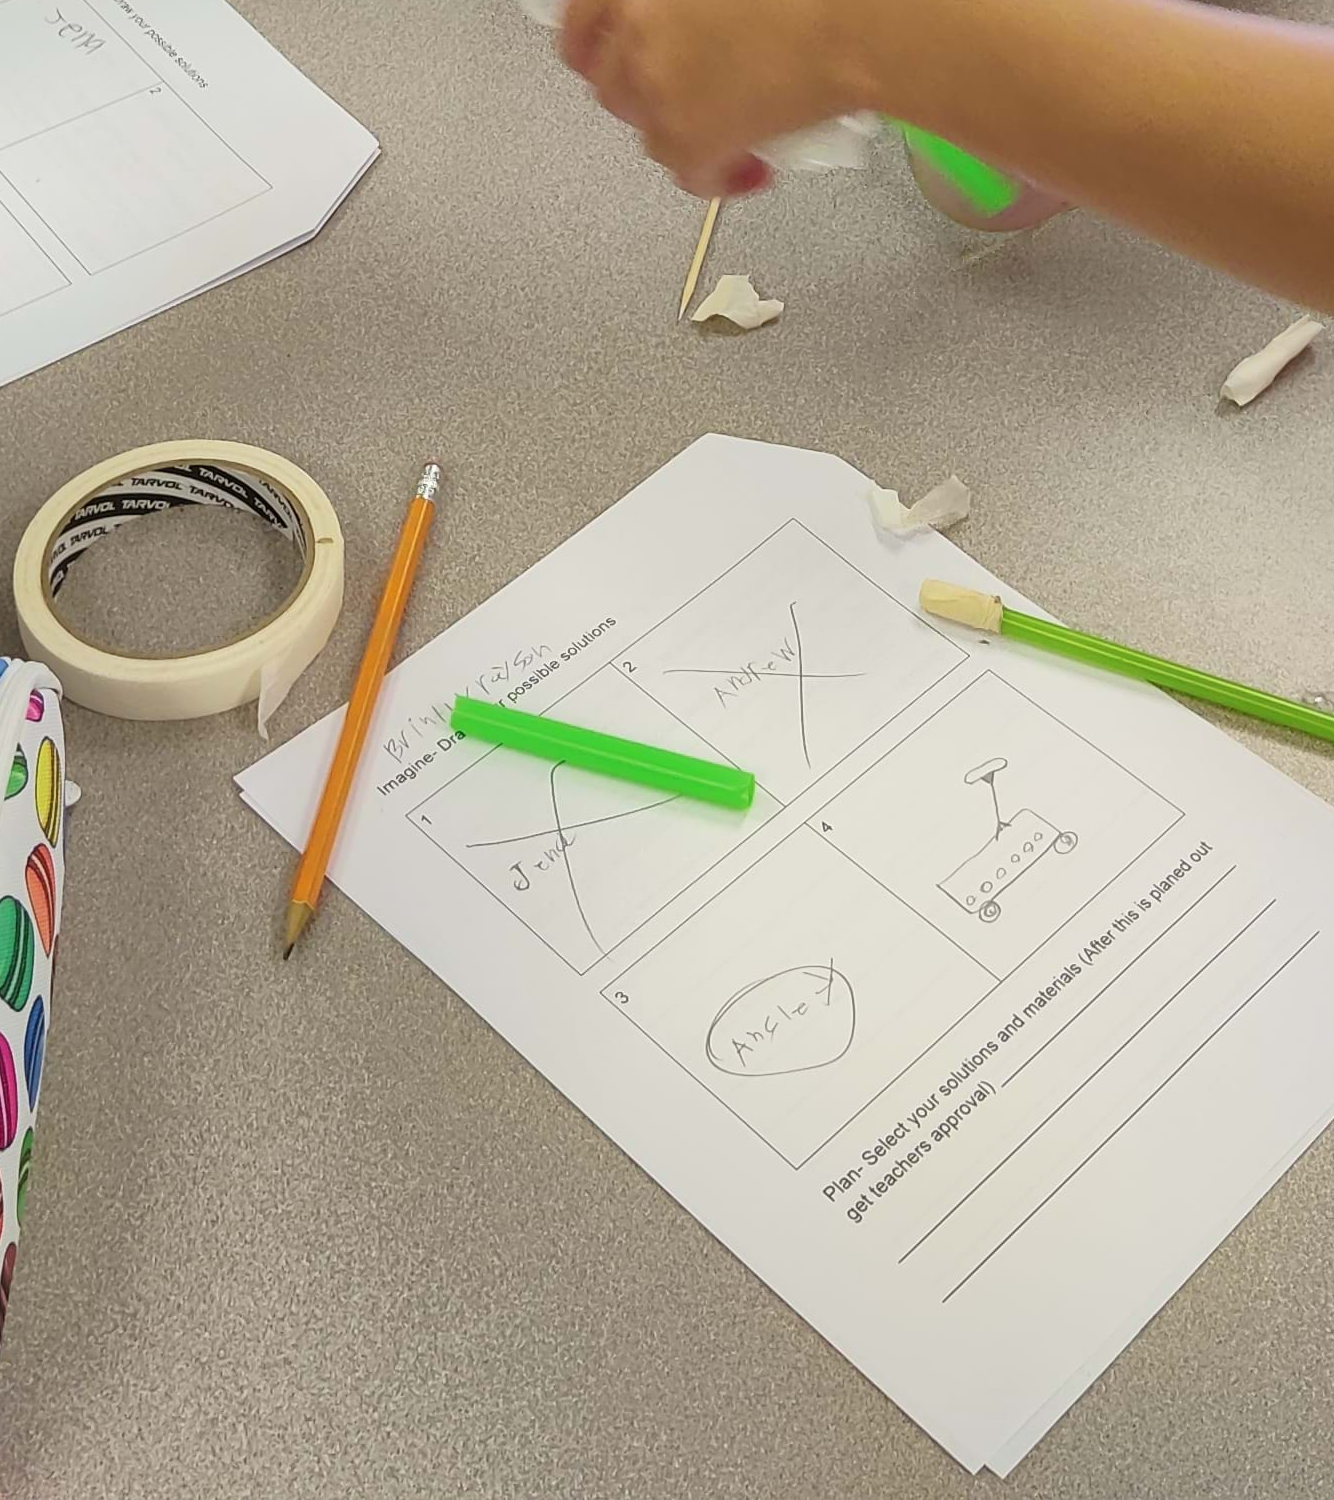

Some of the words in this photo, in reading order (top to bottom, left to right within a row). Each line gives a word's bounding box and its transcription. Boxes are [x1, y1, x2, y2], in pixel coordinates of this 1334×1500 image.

[129, 13, 151, 31] your
[145, 29, 178, 59] possible
[174, 56, 209, 90] solutions
[131, 477, 182, 491] TARVOL
[189, 484, 236, 509] TARVO
[198, 466, 248, 499] TARVOL
[74, 500, 116, 521] TARVOL
[622, 660, 638, 674] 2
[376, 748, 438, 797] Imagine-
[436, 727, 468, 754] Dra
[505, 658, 561, 705] possible
[559, 615, 618, 662] solutions
[420, 813, 433, 826] 1
[821, 820, 834, 833] 4
[614, 990, 630, 1005] 3
[822, 1166, 865, 1203] Plan-
[860, 1121, 912, 1167] Select
[906, 1093, 941, 1131] your
[938, 1039, 1000, 1098] solutions
[996, 1014, 1026, 1044] and
[1022, 962, 1083, 1021] materials
[1077, 930, 1117, 967] (After
[1111, 907, 1141, 935] this
[1137, 895, 1153, 914] is
[1147, 859, 1193, 903] planed
[1189, 839, 1215, 865] out
[846, 1192, 874, 1225] get
[869, 1138, 933, 1198] teachers
[930, 1078, 998, 1144] approval)
